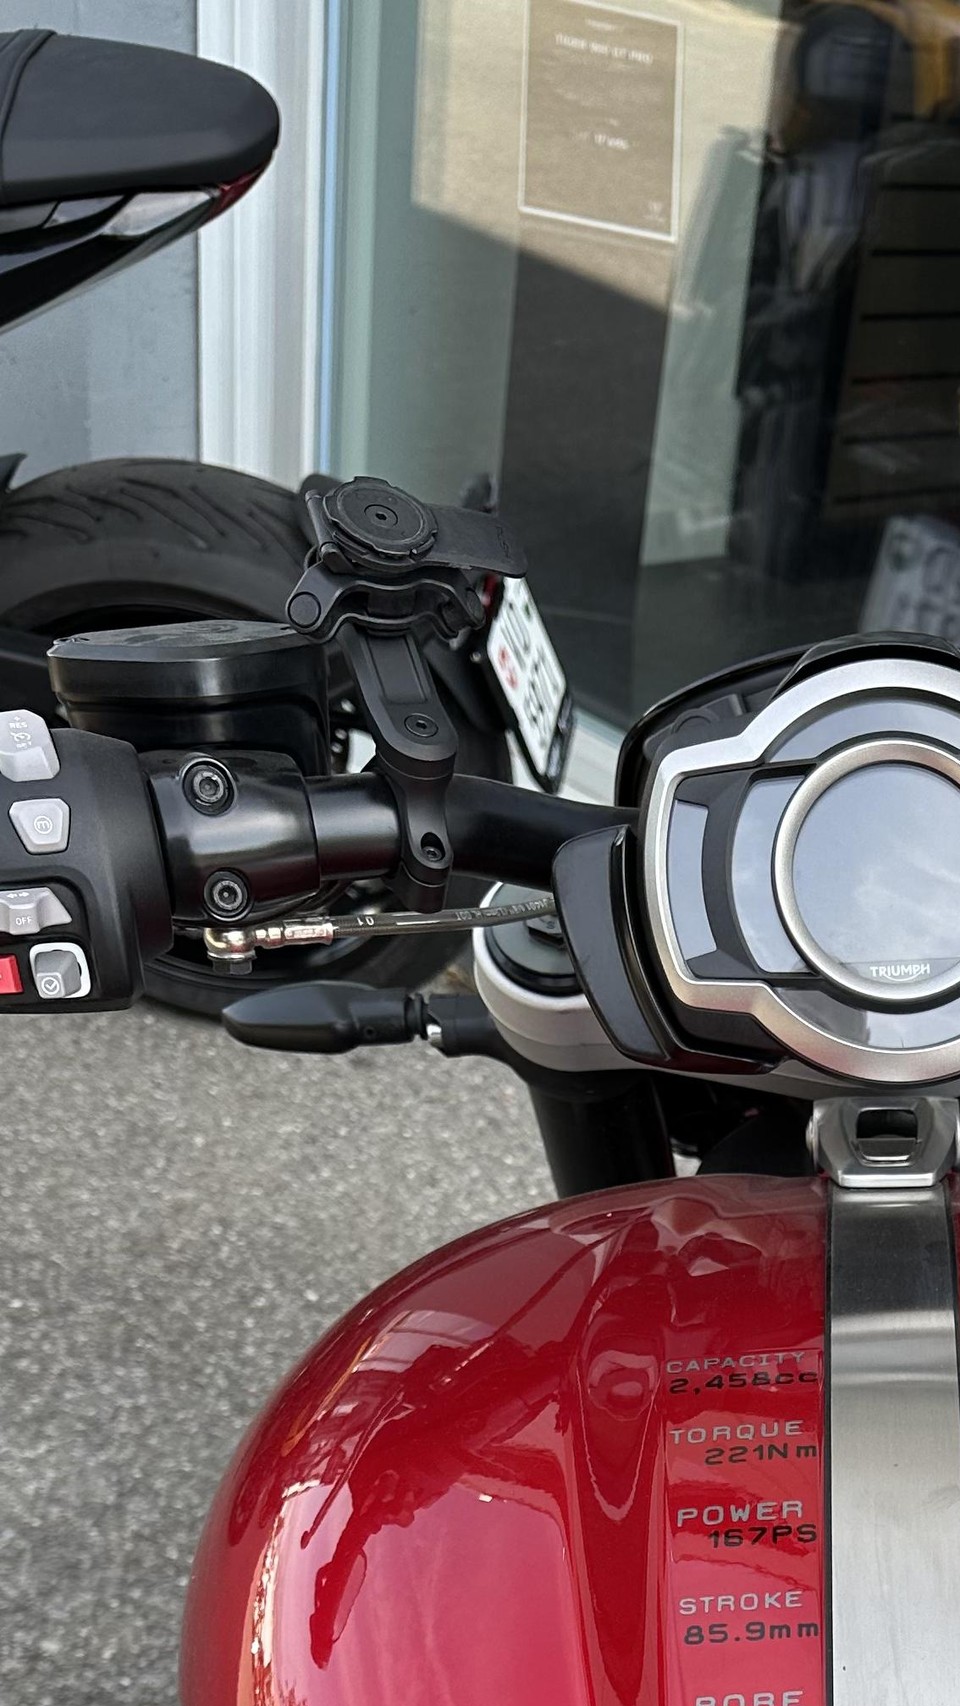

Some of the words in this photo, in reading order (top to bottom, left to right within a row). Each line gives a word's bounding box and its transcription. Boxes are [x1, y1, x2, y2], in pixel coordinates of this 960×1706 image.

[9, 721, 28, 729] RES
[15, 916, 33, 926] OFF
[869, 963, 931, 982] TRIUMPH
[666, 1351, 805, 1374] CAPACITY
[669, 1371, 818, 1395] 2,458cc
[669, 1420, 804, 1445] TORQUE
[677, 1500, 803, 1528] POWER
[708, 1524, 818, 1549] 167PS
[679, 1589, 803, 1615] STROKE
[683, 1621, 820, 1646] 85.9mm
